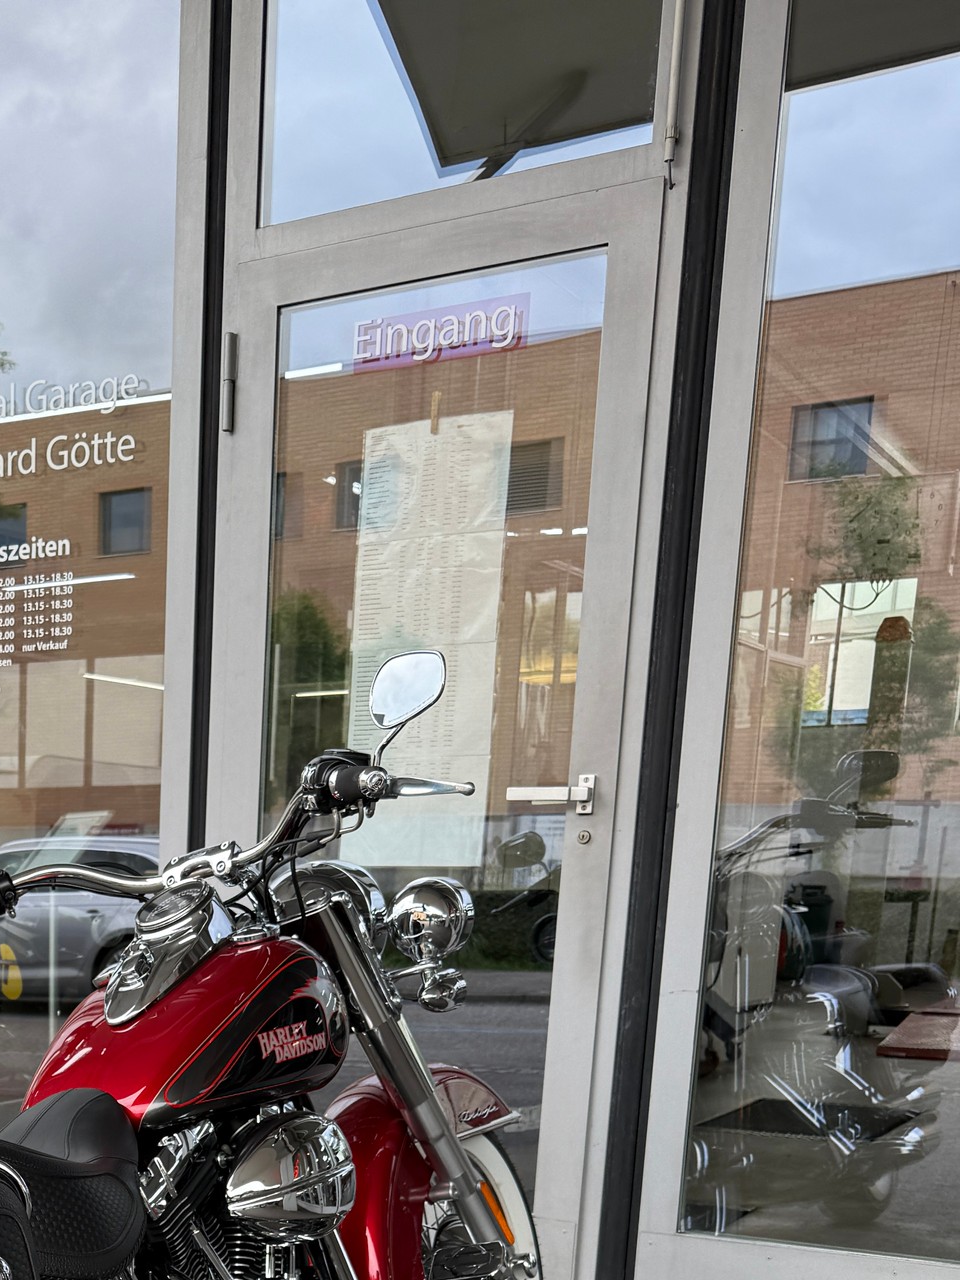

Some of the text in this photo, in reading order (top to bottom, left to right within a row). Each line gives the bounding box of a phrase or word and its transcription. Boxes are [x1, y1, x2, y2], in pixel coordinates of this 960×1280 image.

[353, 304, 518, 361] Eingang
[25, 373, 139, 415] Garage
[46, 431, 136, 471] Götte
[23, 574, 45, 585] 13.15
[51, 572, 73, 582] 18.30
[23, 588, 45, 598] 13.15
[51, 586, 73, 596] 18.30
[23, 602, 45, 612] 13.15
[50, 599, 73, 609] 18.30
[23, 615, 45, 625] 13.15
[50, 613, 73, 623] 18.30
[23, 628, 44, 638] 13.15
[50, 626, 72, 636] 18.30
[22, 644, 36, 652] nur
[37, 640, 68, 651] Verkauf
[257, 1020, 308, 1060] HARLEY
[274, 1032, 327, 1064] DAVIDSON
